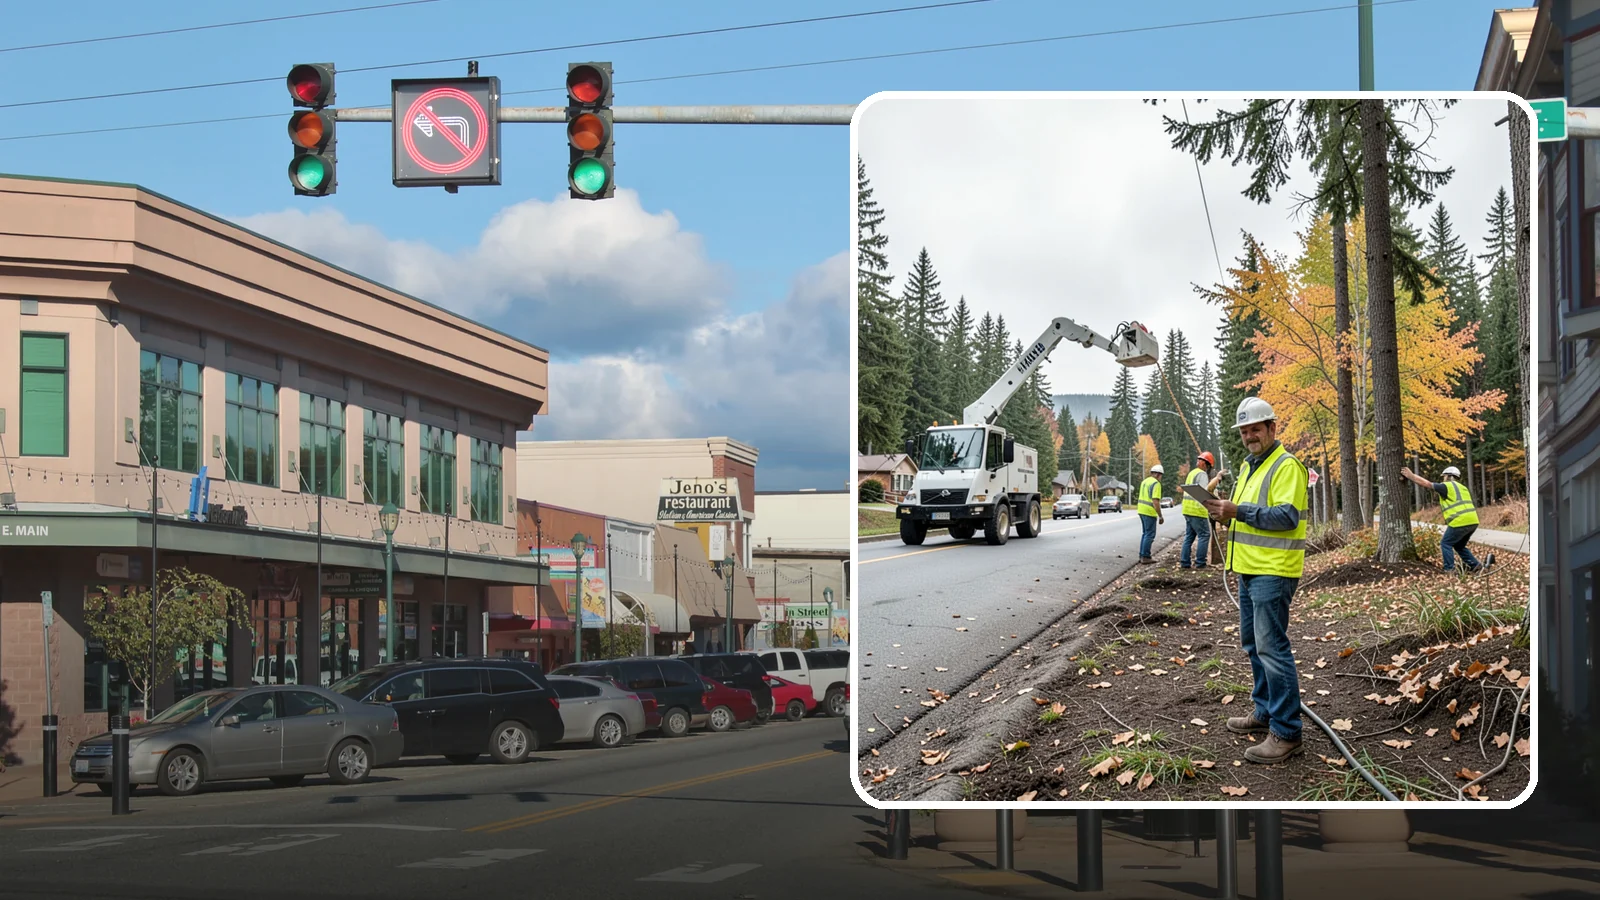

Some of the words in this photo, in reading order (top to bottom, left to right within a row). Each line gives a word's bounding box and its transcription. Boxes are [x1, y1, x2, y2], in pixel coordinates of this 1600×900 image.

[670, 480, 727, 494] Jeno's
[665, 496, 731, 509] restaurant
[658, 509, 681, 519] Italian
[686, 510, 714, 519] American
[715, 510, 737, 519] Cuisine
[2, 525, 13, 536] E.
[15, 525, 49, 536] MAIN
[797, 607, 828, 617] Street
[790, 619, 824, 627] lass
